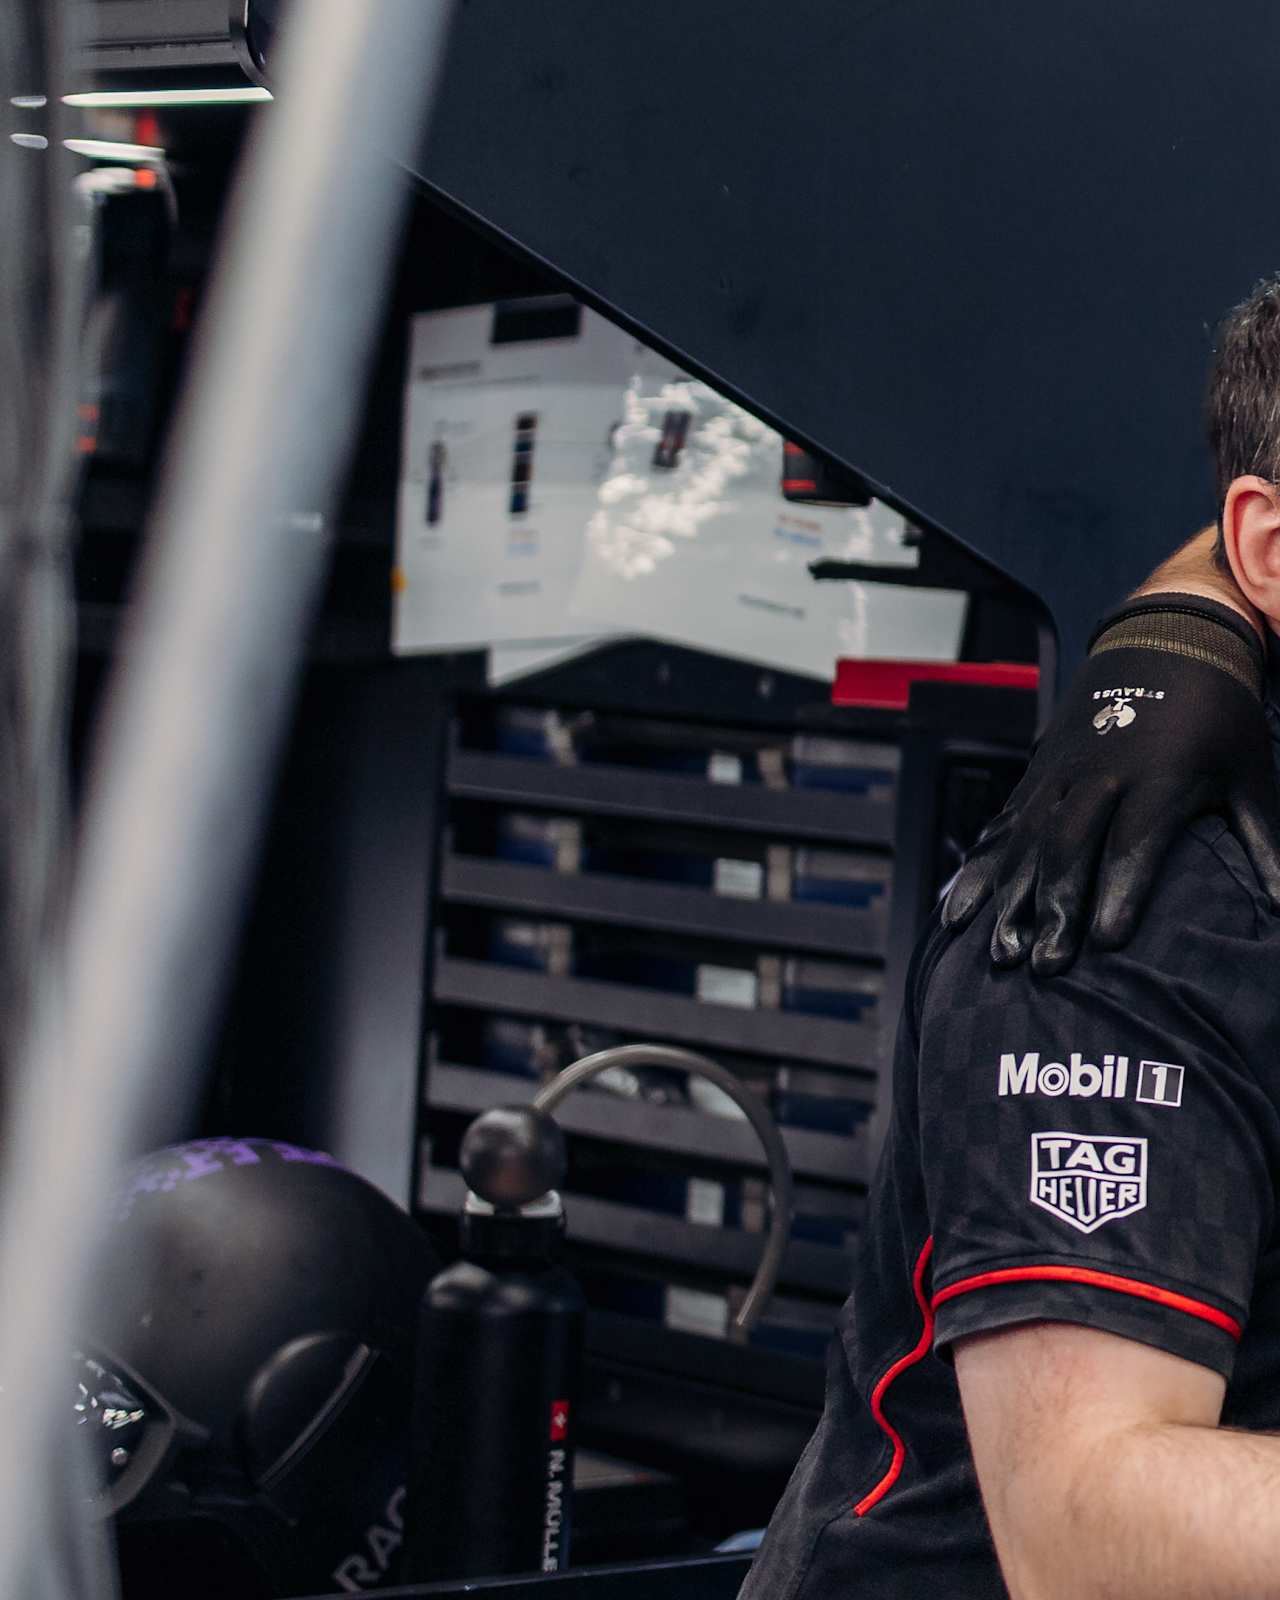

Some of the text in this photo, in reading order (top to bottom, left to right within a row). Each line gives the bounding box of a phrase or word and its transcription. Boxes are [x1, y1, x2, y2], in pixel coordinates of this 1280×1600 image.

[1092, 687, 1165, 700] STRAUSS
[998, 1052, 1129, 1098] Mobil
[1039, 1139, 1137, 1175] TAG
[1038, 1176, 1139, 1225] HEUER
